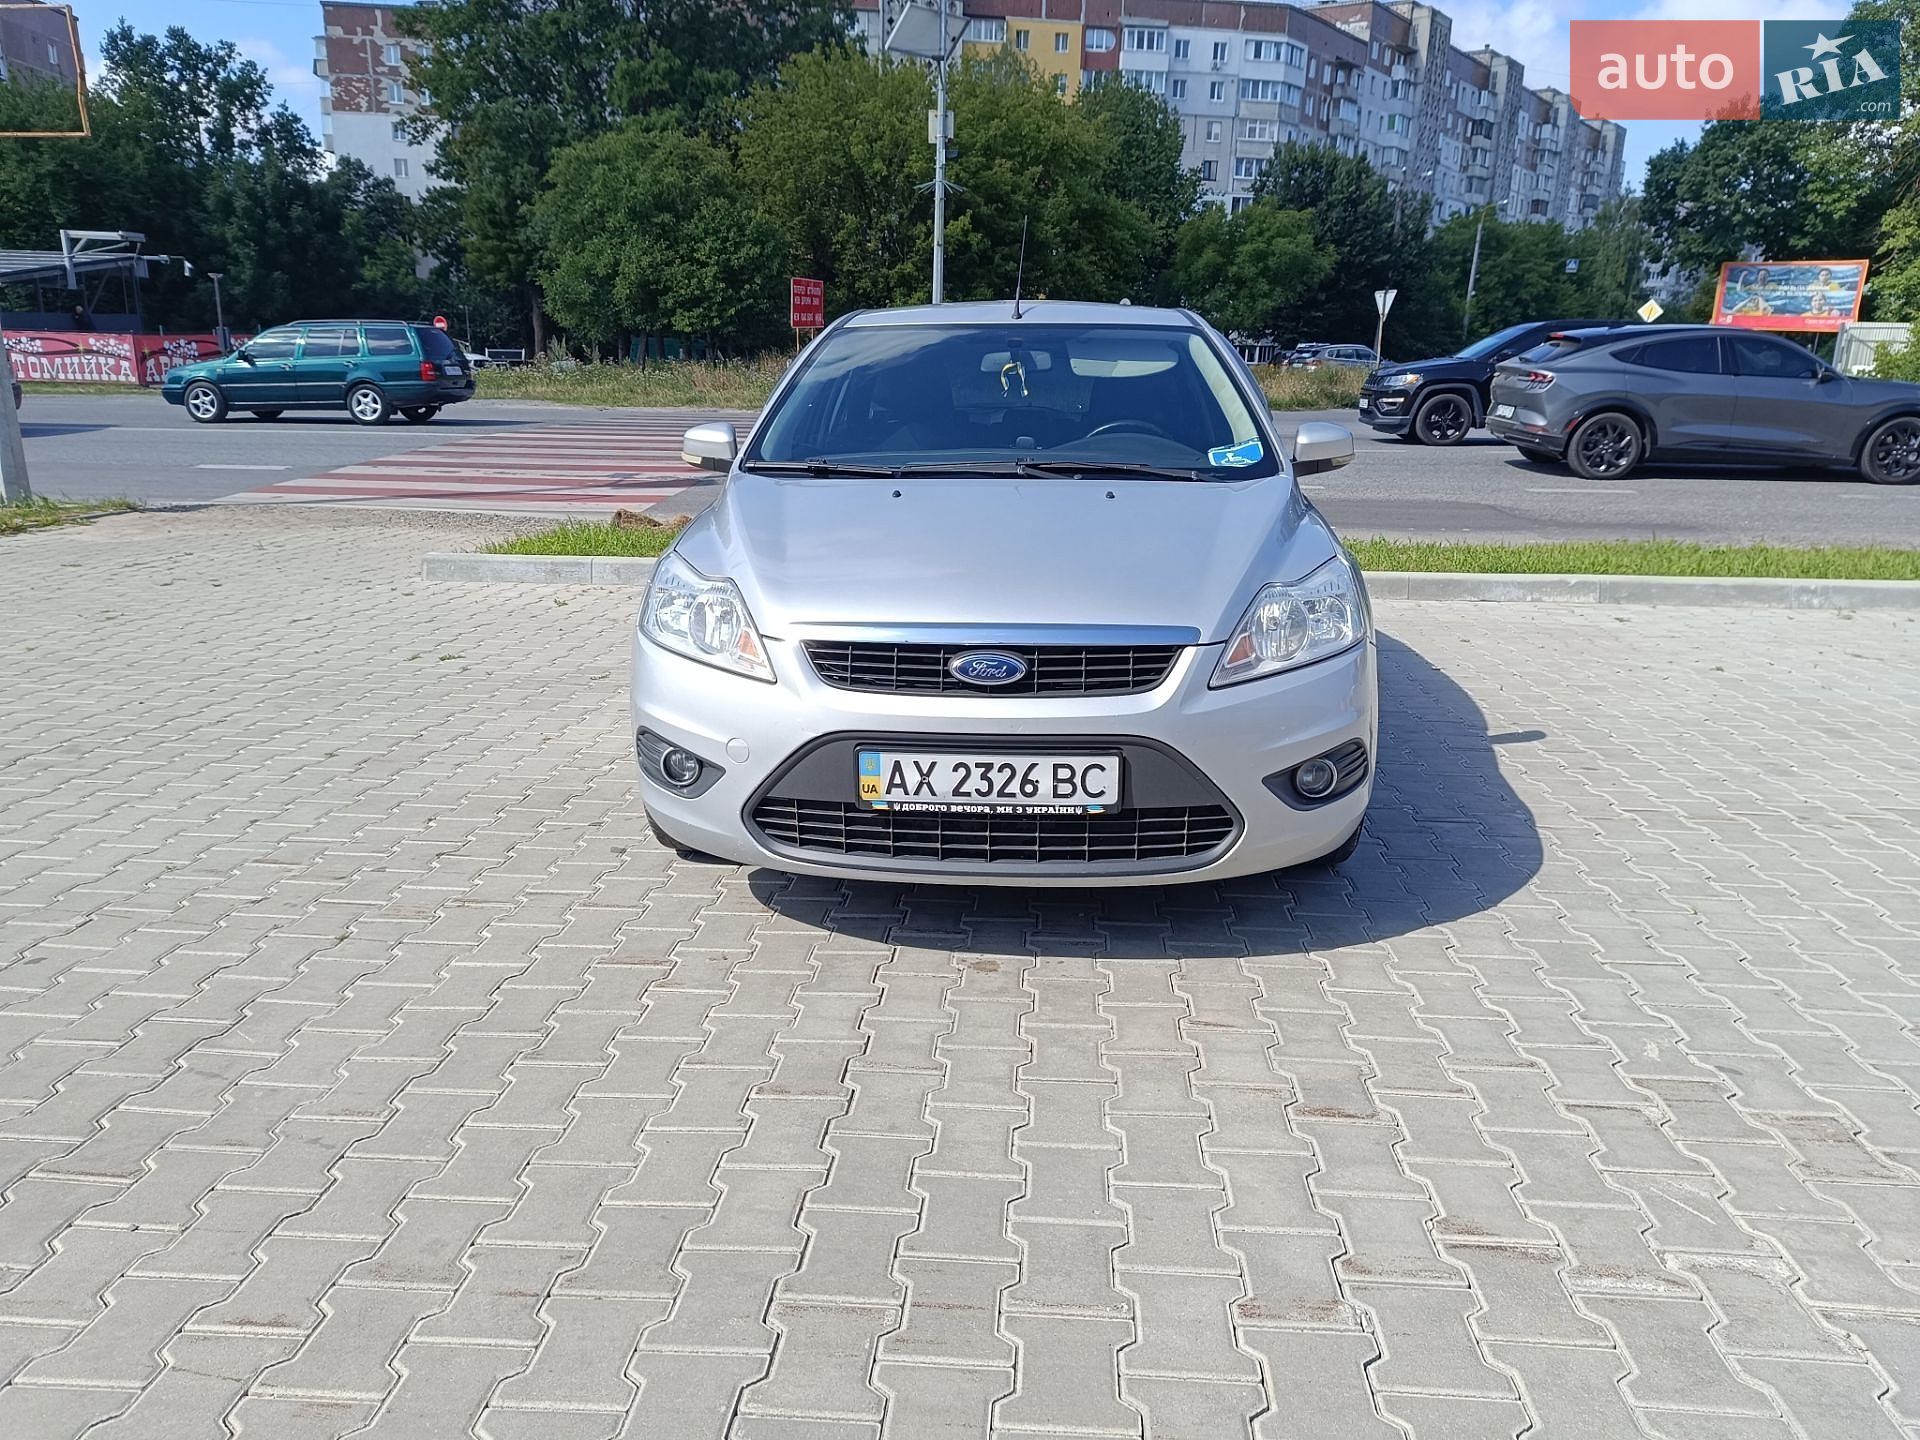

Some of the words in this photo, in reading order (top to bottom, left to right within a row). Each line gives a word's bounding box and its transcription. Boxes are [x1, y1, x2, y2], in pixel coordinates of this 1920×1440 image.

[10, 353, 136, 382] ТОМИЙКА
[968, 660, 1007, 677] Ford
[862, 783, 878, 794] UA
[885, 760, 938, 797] AX
[951, 761, 1040, 799] 2326
[1052, 763, 1107, 799] BC
